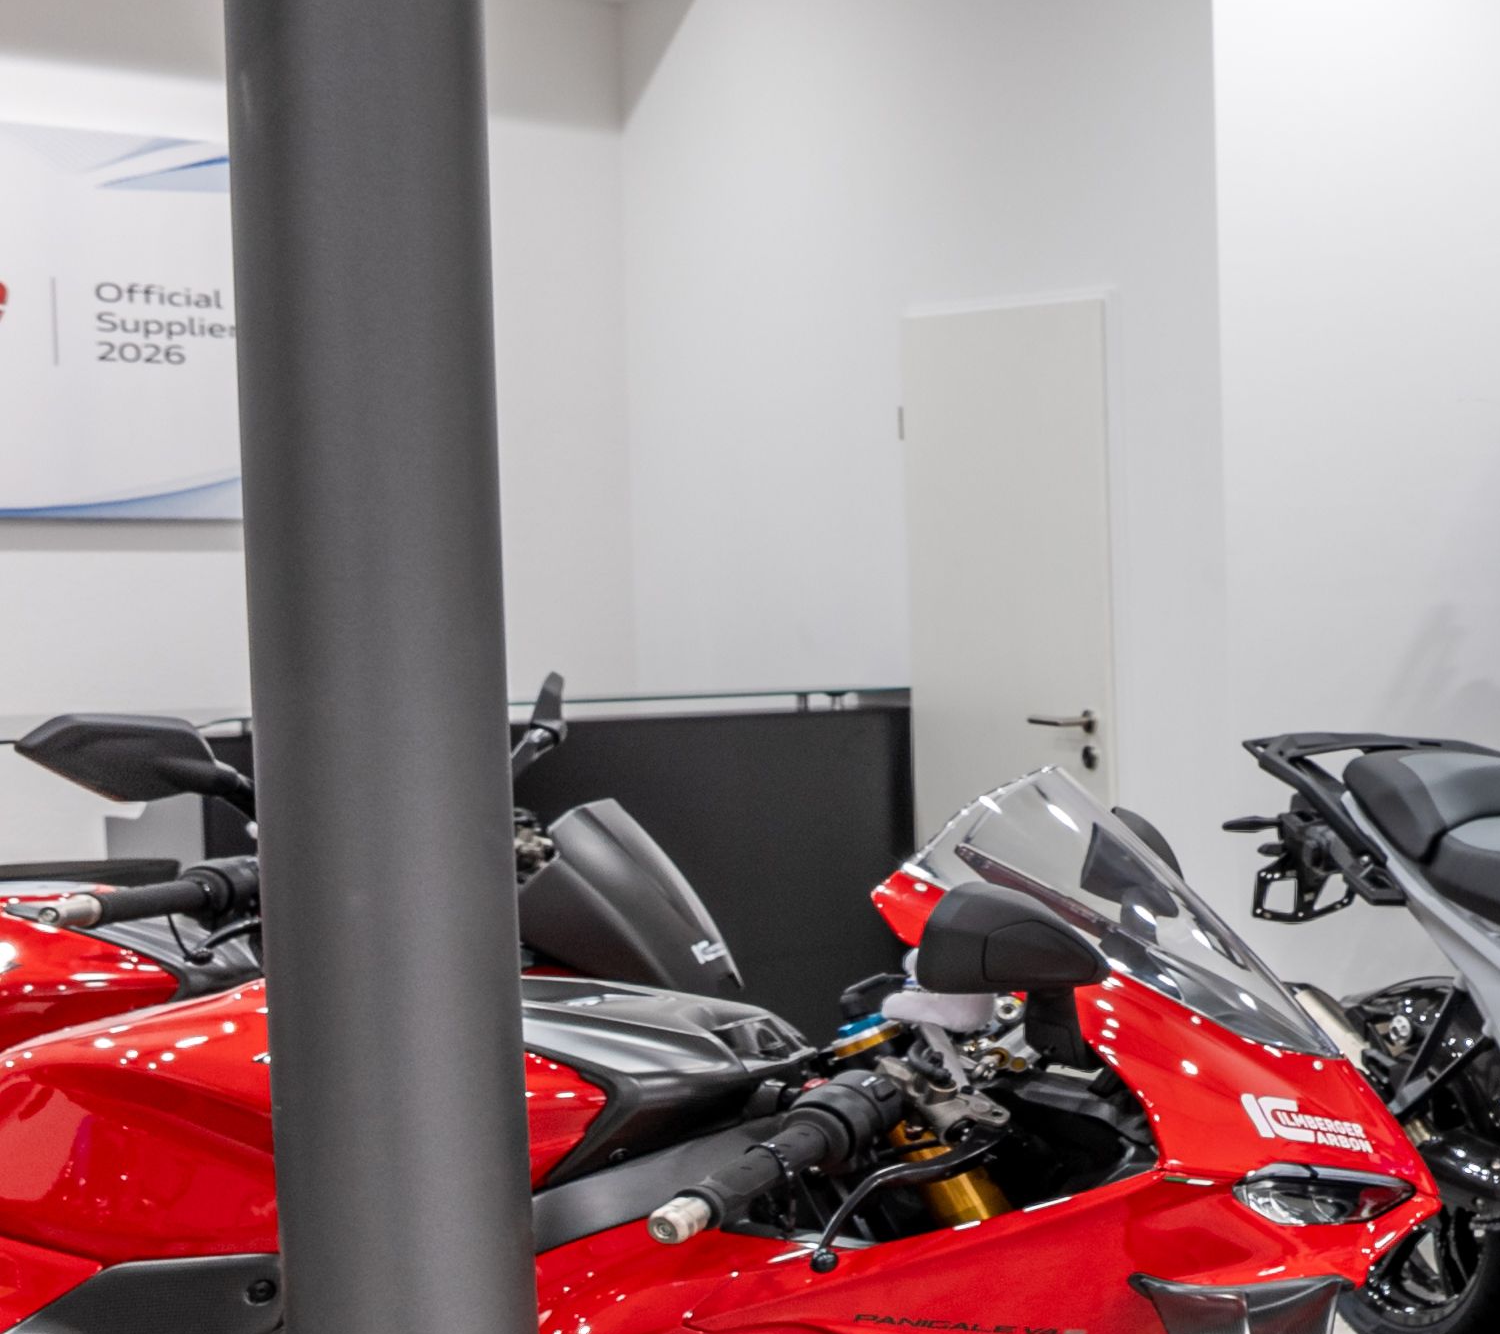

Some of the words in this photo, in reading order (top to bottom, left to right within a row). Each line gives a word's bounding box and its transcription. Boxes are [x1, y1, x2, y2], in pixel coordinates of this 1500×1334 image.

[95, 282, 223, 309] Official
[97, 341, 186, 365] 2026
[1276, 1111, 1366, 1138] ILMBERGER
[853, 1314, 1017, 1334] PANIGALE
